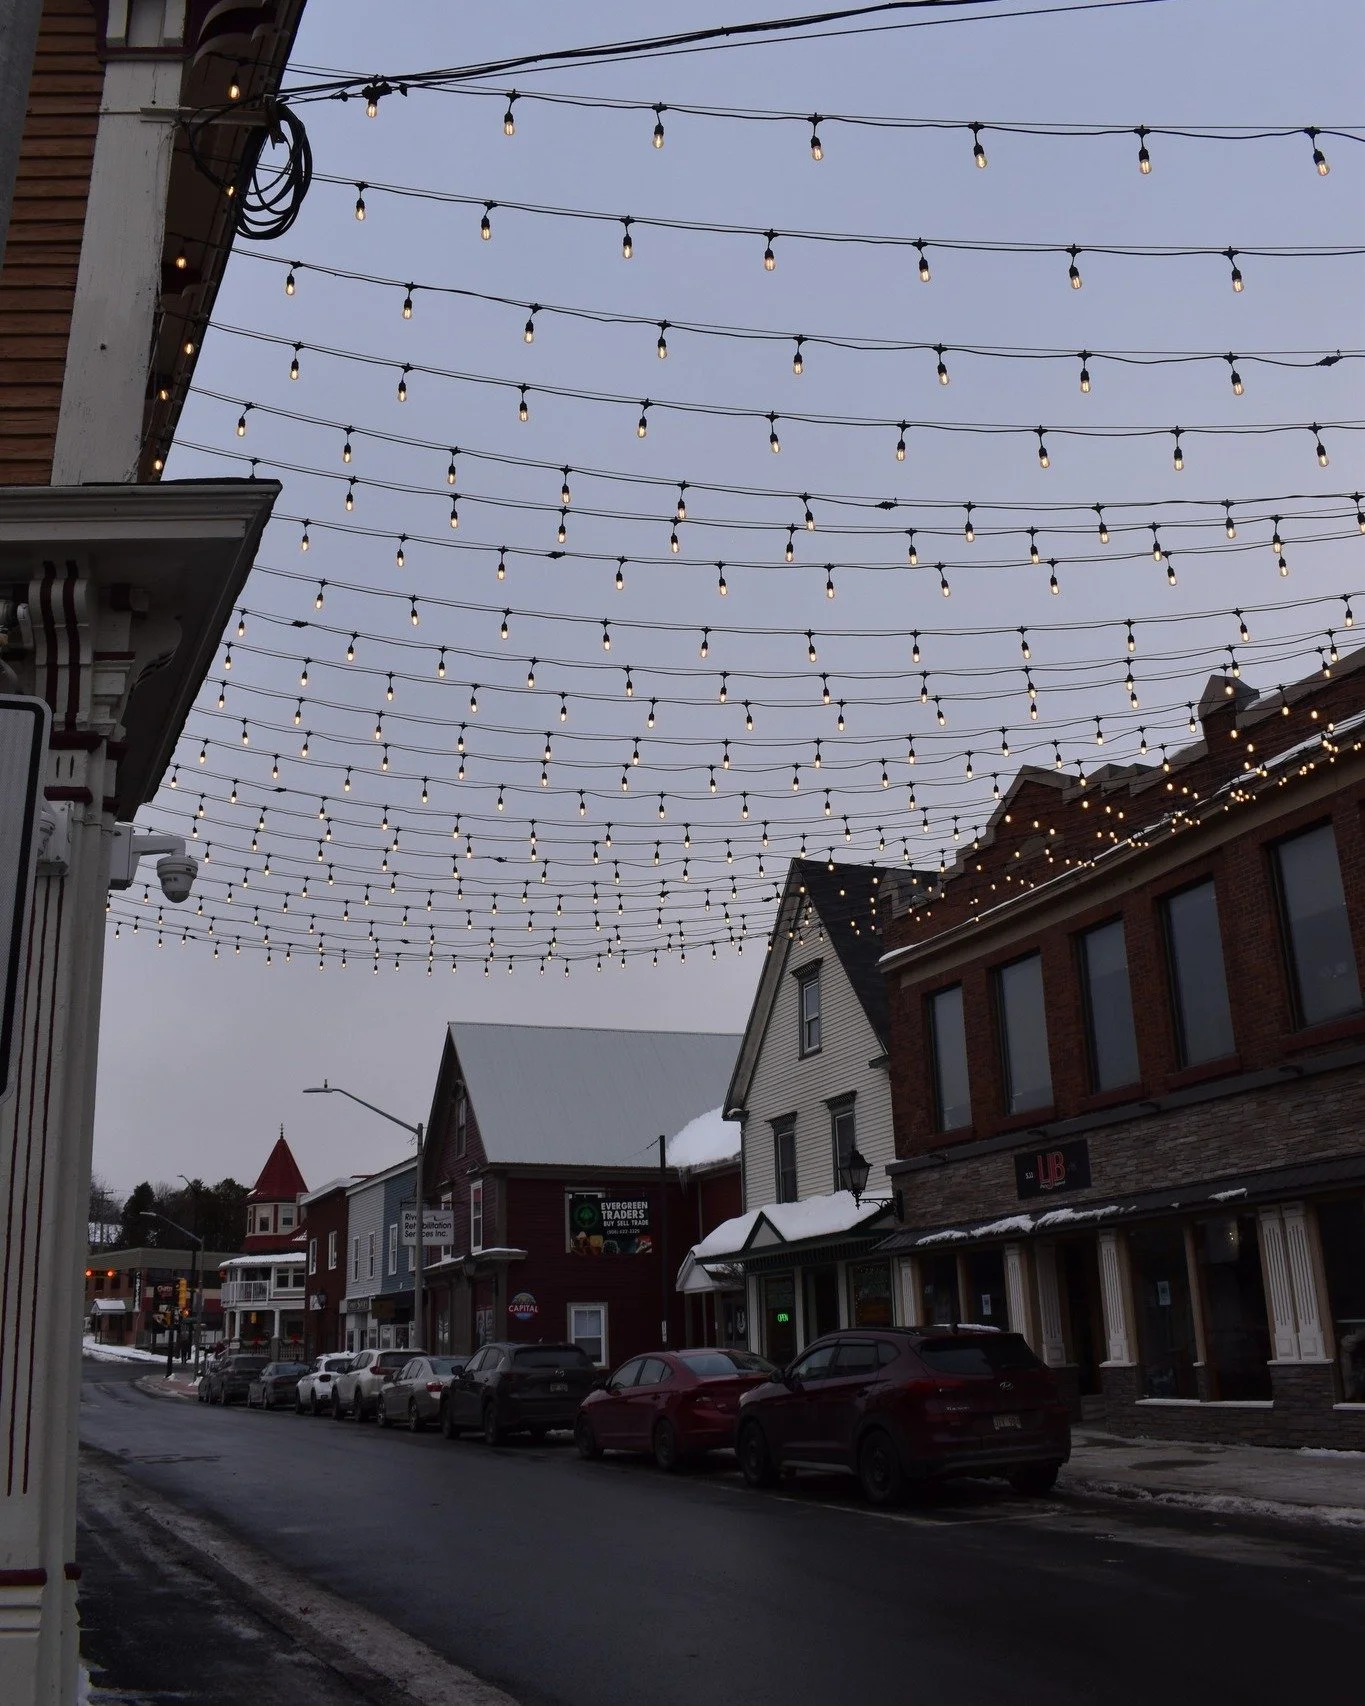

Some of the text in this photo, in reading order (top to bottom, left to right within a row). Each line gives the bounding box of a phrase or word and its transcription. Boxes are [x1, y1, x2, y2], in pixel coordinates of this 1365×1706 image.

[601, 1201, 649, 1211] EVERGREEN
[601, 1210, 645, 1220] TRADERS
[617, 1219, 630, 1227] SELL
[404, 1230, 434, 1238] Serices
[508, 1304, 539, 1313] CAPITAL
[777, 1313, 789, 1322] OPEN
